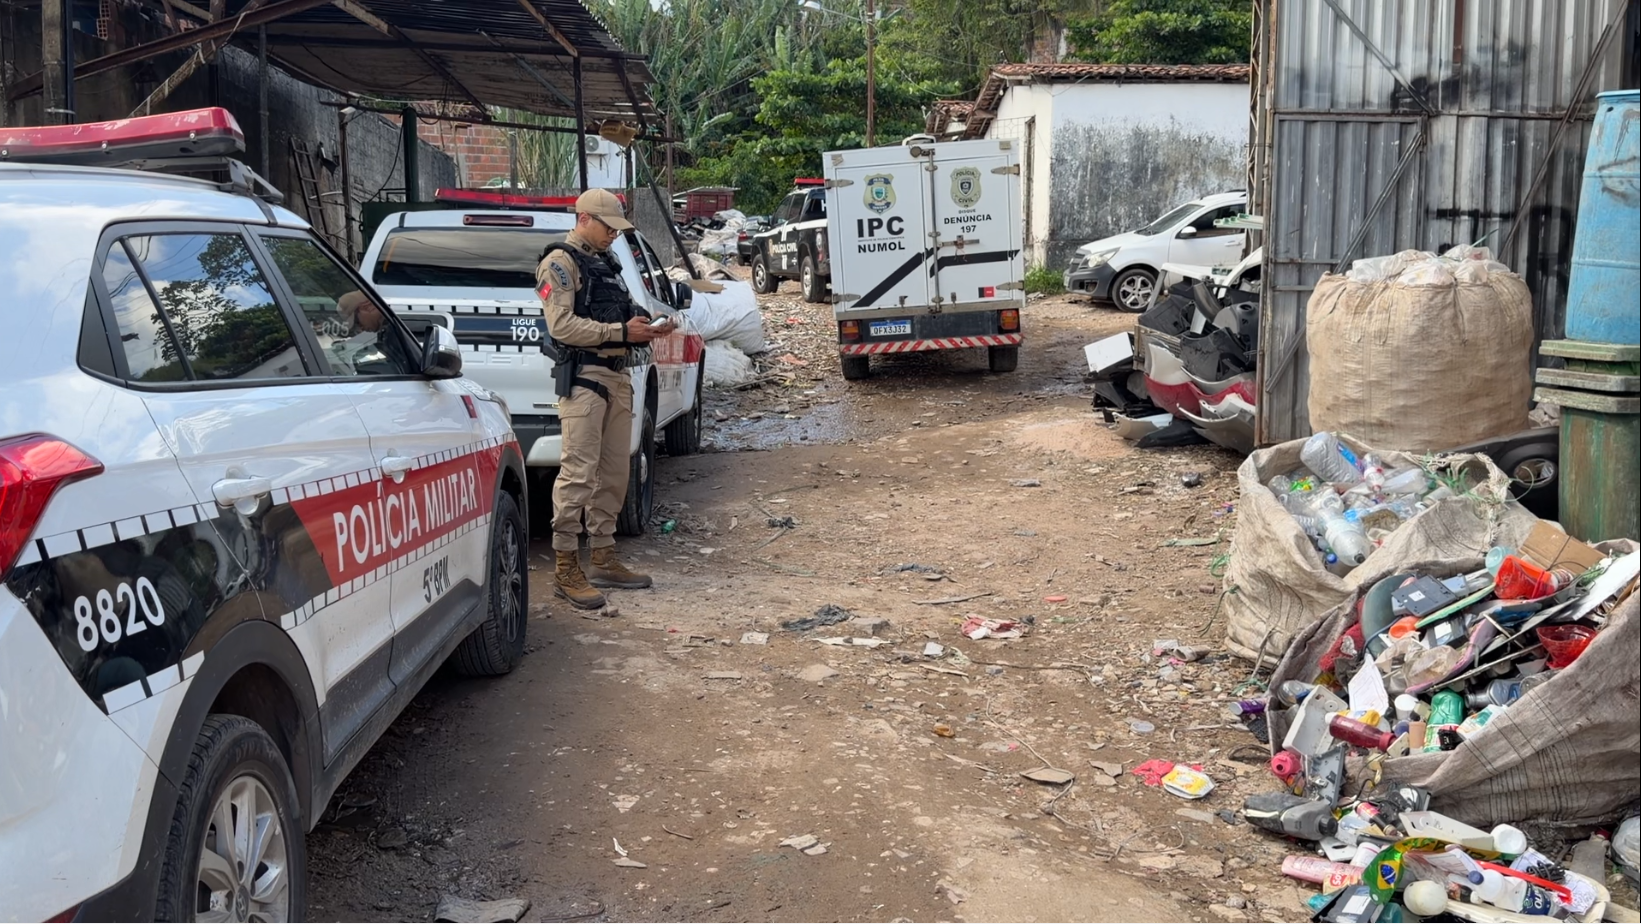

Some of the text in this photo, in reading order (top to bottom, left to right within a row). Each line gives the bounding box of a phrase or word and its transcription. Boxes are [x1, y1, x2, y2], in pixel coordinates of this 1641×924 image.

[943, 214, 992, 225] DENÚNCIA
[857, 215, 905, 239] IPC
[960, 224, 977, 233] 197
[857, 241, 906, 254] NUMOL
[512, 318, 537, 326] LIGUE
[510, 325, 540, 342] 190
[873, 325, 907, 335] QFX3J32
[333, 467, 478, 573] POLÍCIA MILITAR
[73, 576, 165, 652] 8820
